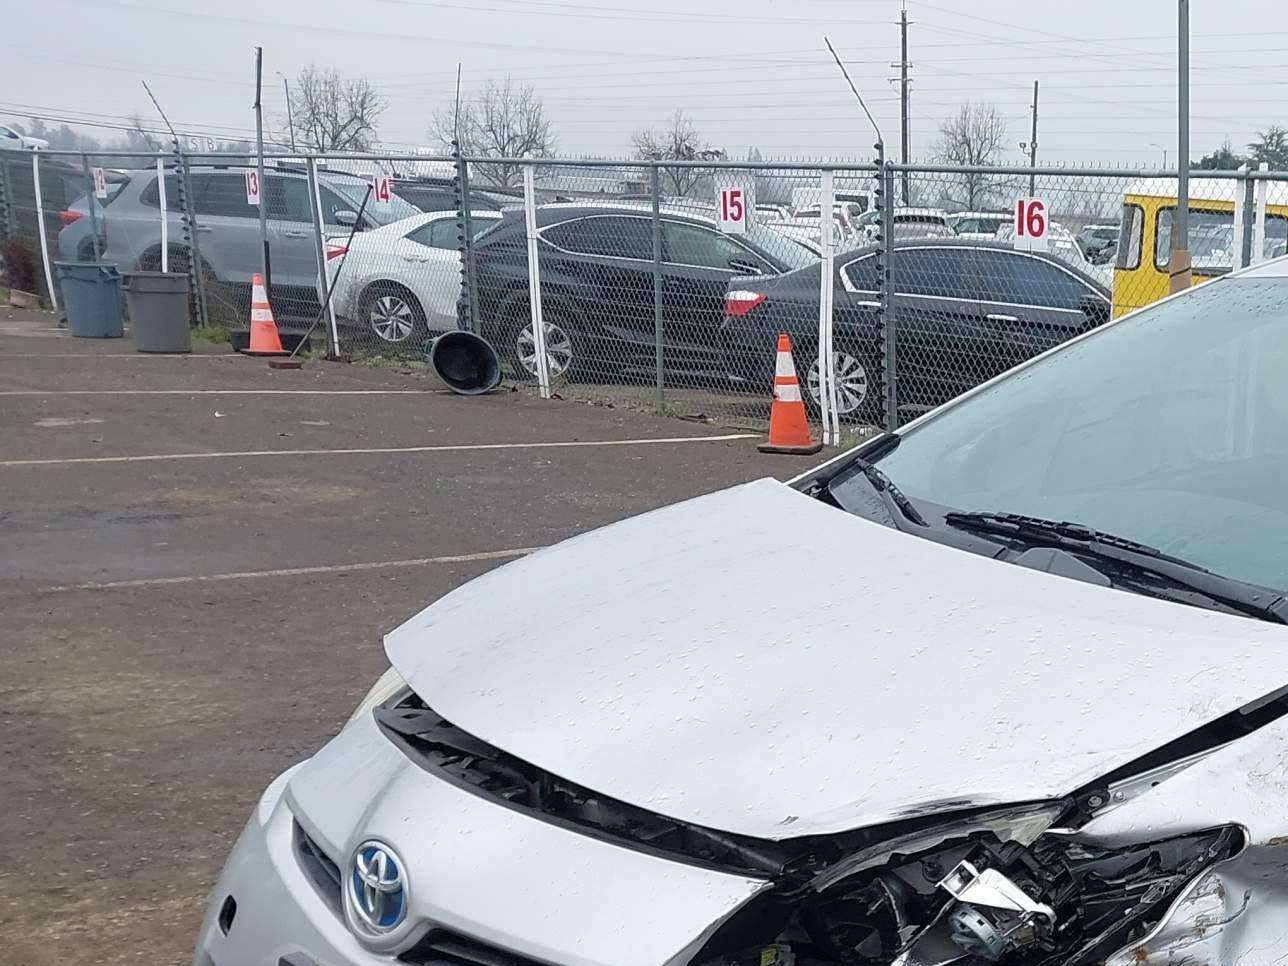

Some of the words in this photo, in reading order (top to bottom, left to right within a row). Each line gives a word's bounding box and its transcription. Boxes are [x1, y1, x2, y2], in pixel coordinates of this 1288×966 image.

[246, 172, 258, 196] 13
[374, 178, 390, 203] 14
[721, 190, 743, 222] 15
[1016, 200, 1045, 238] 16
